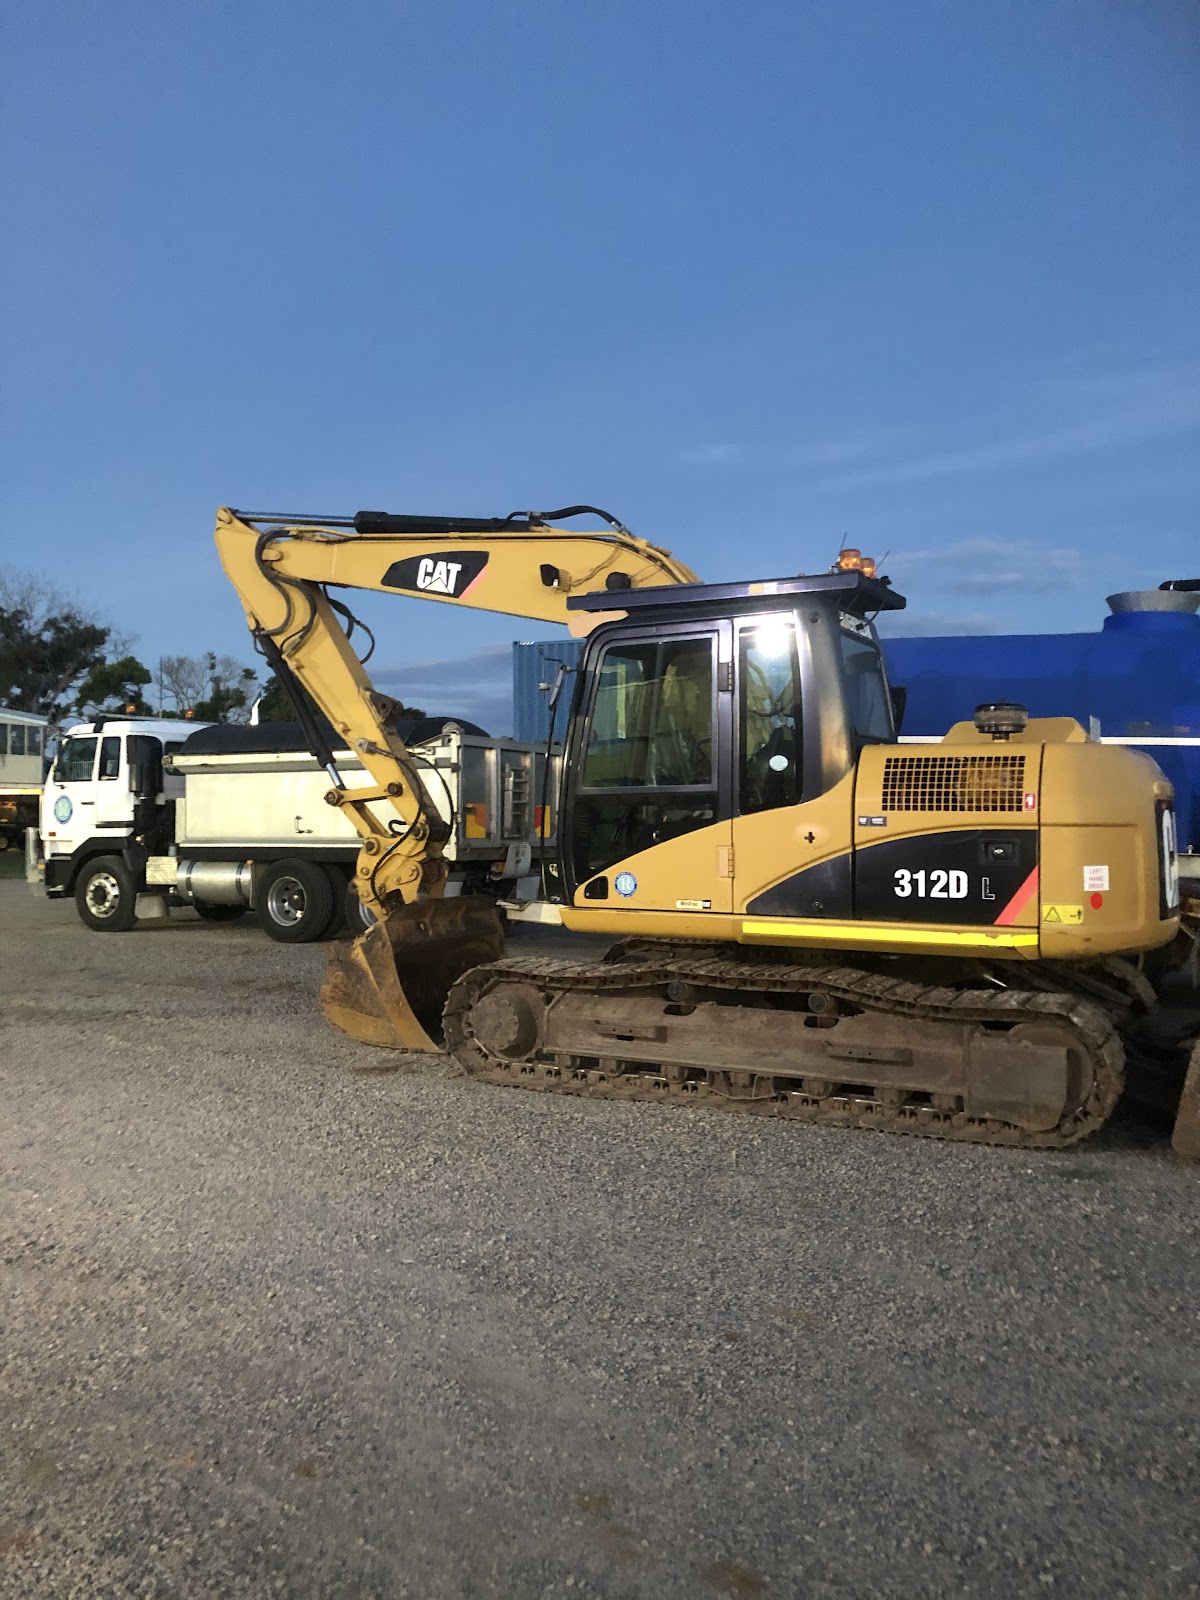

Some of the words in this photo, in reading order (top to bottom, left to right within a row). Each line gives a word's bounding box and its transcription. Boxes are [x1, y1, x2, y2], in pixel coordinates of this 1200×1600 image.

[416, 558, 462, 594] CAT
[894, 868, 968, 898] 312D
[981, 877, 996, 900] L
